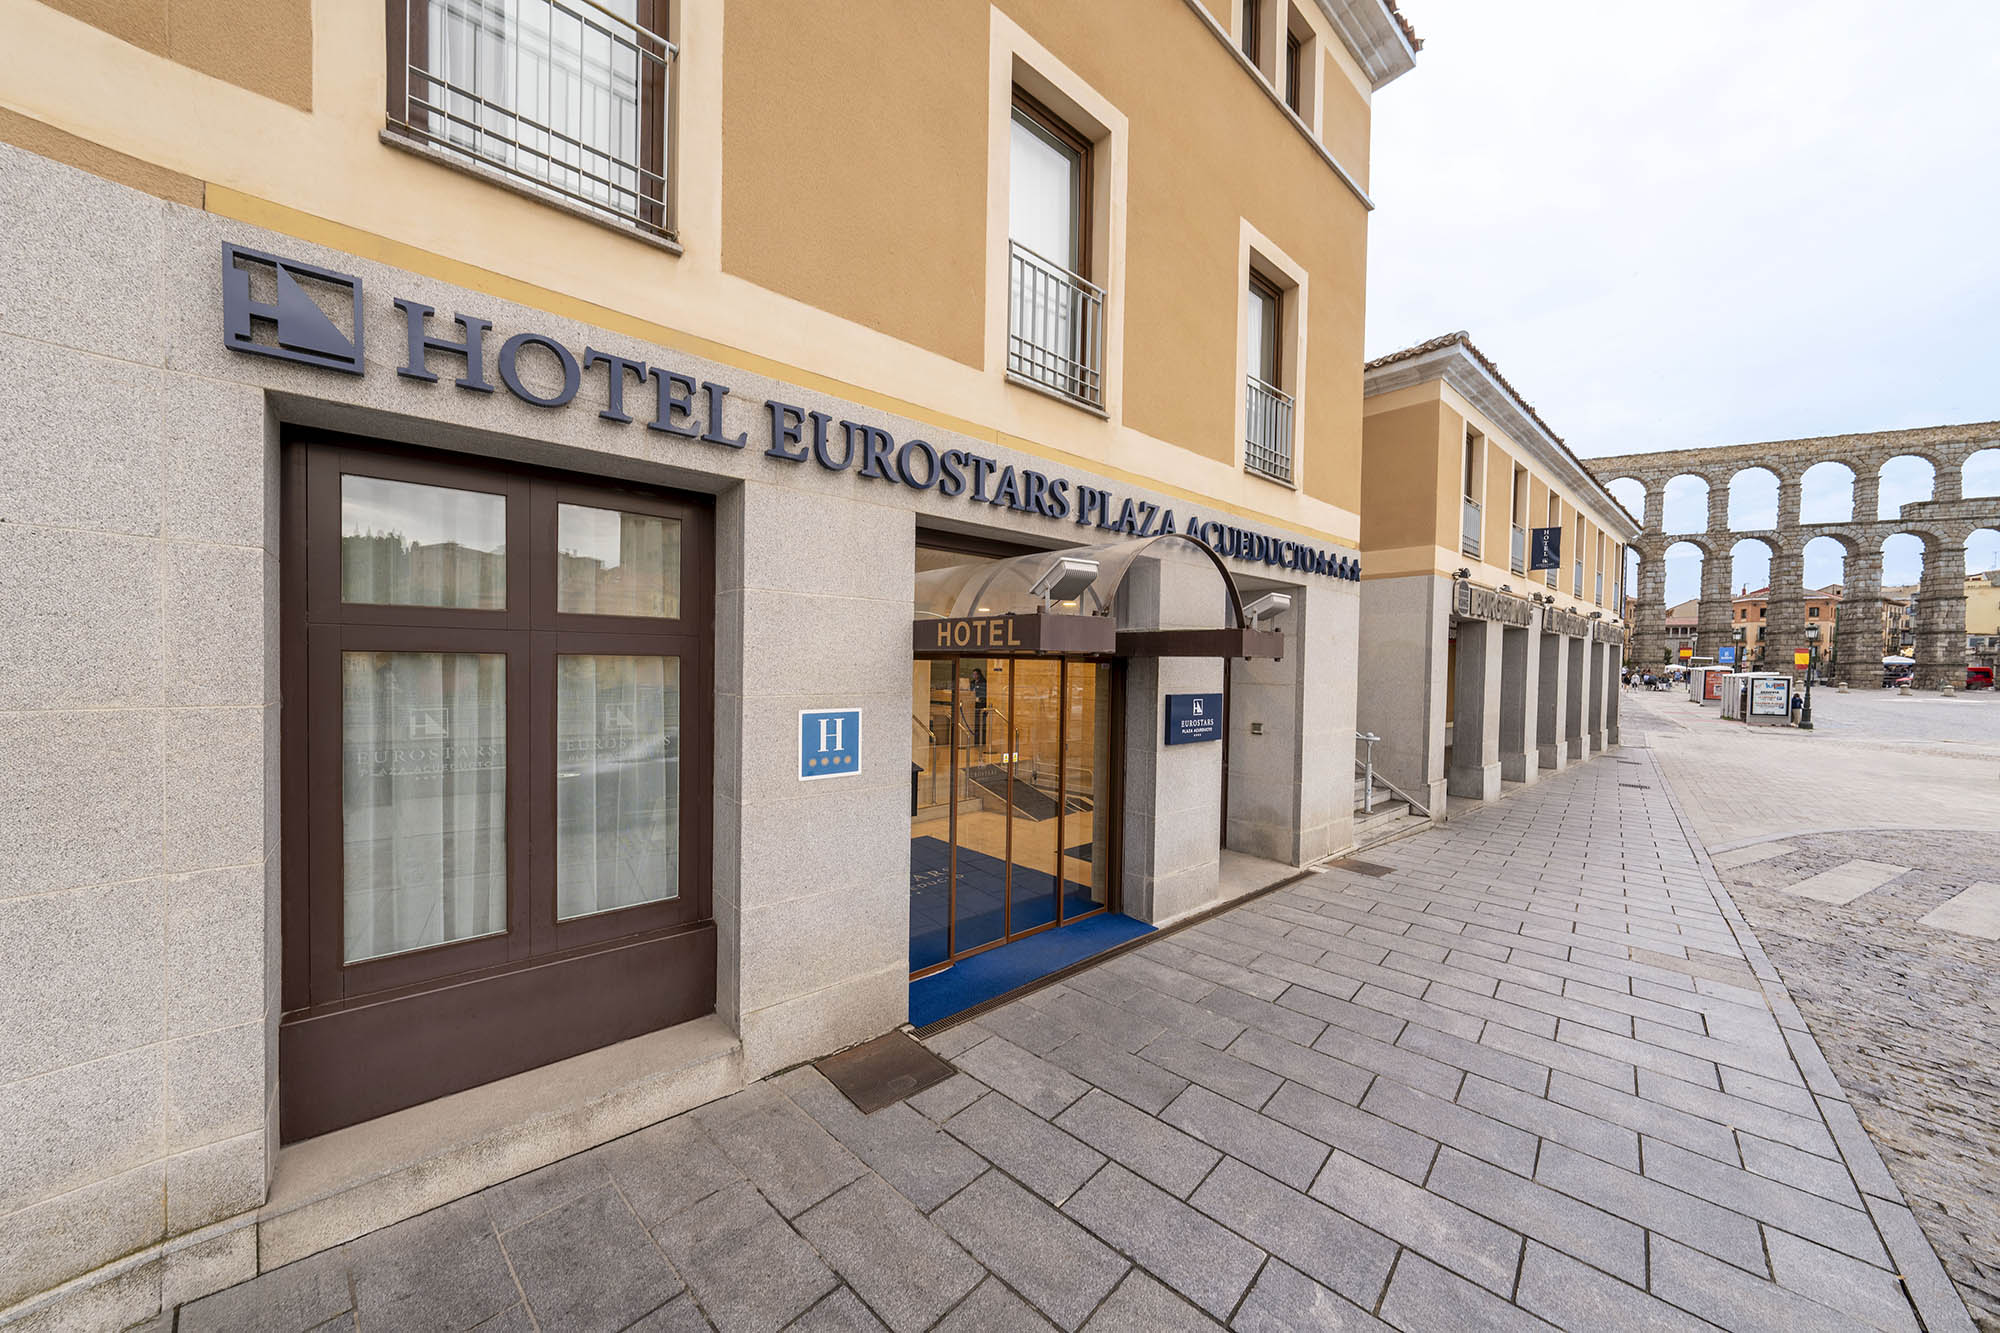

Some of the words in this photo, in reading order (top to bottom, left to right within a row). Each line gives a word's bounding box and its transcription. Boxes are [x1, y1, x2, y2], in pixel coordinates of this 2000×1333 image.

[394, 297, 747, 449] HOTEL
[765, 400, 1070, 519] EUROSTARS
[1076, 485, 1176, 537] PLAZA
[1186, 516, 1317, 573] ACUEDUCTO
[937, 619, 1021, 647] HOTEL
[817, 718, 845, 752] H
[1181, 718, 1214, 728] EUROSTARS
